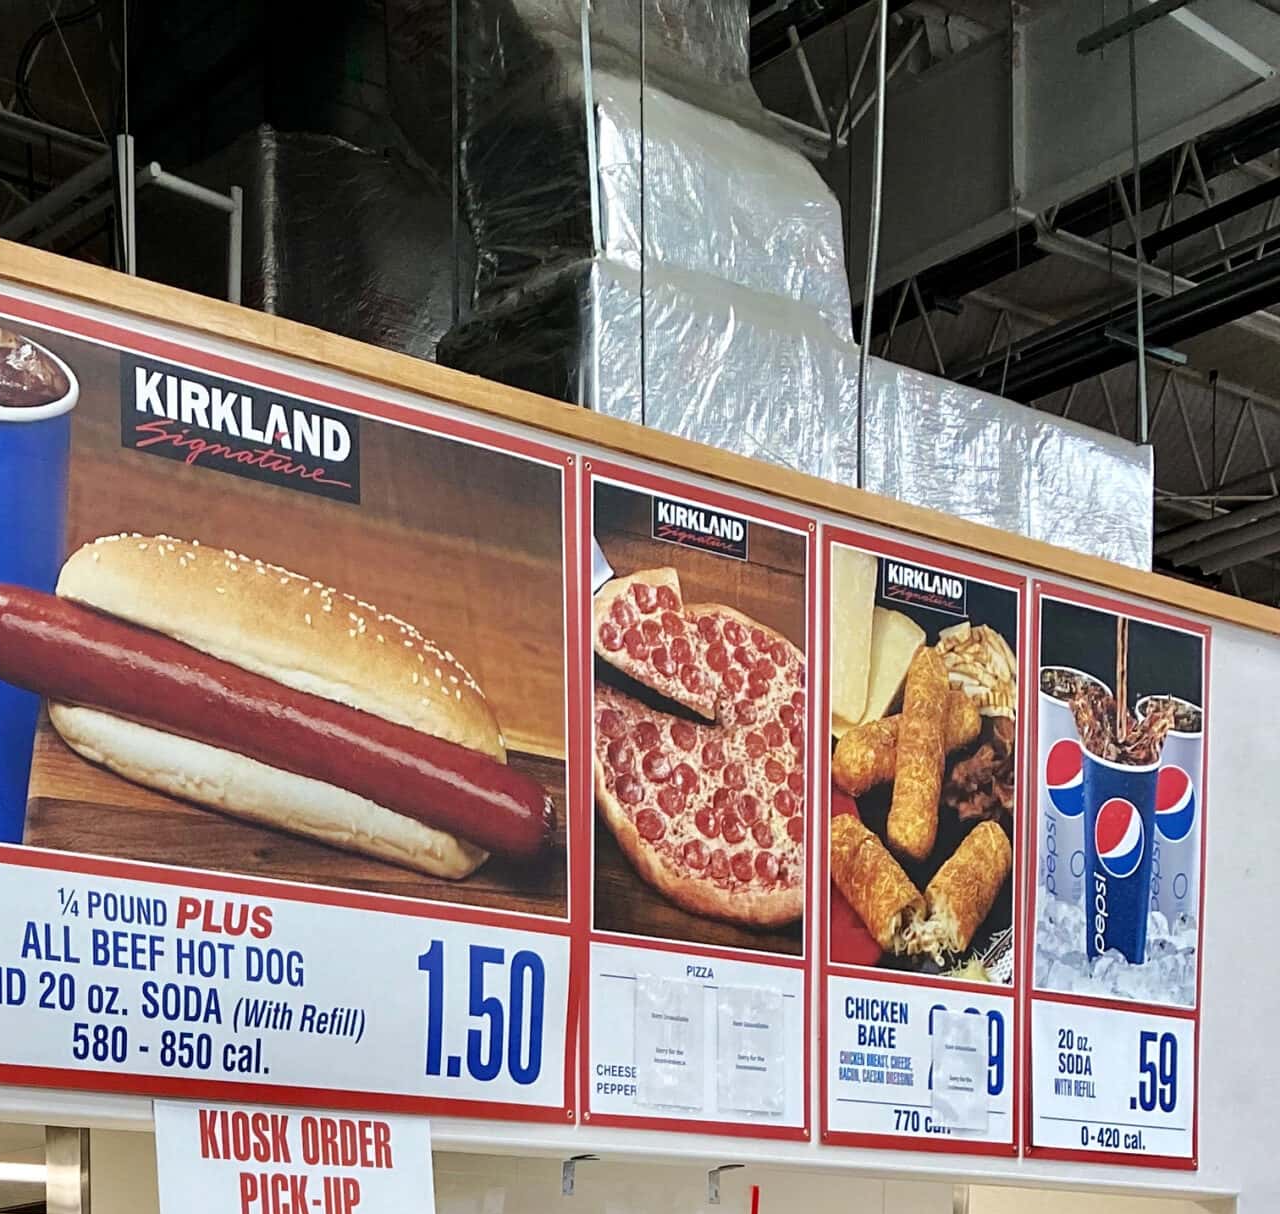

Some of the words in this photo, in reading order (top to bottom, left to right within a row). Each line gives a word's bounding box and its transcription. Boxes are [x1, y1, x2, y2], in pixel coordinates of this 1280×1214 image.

[135, 366, 351, 462] KIRKLAND
[135, 419, 352, 488] Signature
[658, 501, 744, 542] KIRKLAND
[888, 563, 963, 599] KIRKLAND
[86, 892, 167, 927] POUND
[175, 896, 273, 939] PLUS
[20, 921, 80, 964] ALL
[92, 928, 165, 971] BEEF
[175, 938, 235, 980] HOT
[245, 946, 305, 988] DOG
[686, 965, 714, 980] PIZZA
[38, 971, 75, 1012] 20
[87, 986, 128, 1016] oz.
[141, 983, 222, 1025] SODA
[232, 995, 294, 1035] (With
[298, 1004, 367, 1045] Refill)
[417, 938, 546, 1086] 1.50
[845, 996, 909, 1024] CHICKEN
[72, 1022, 128, 1062] 580
[159, 1032, 212, 1071] 850
[222, 1038, 271, 1076] cal.
[858, 1024, 896, 1049] BAKE
[1058, 1029, 1074, 1049] 20
[1077, 1036, 1092, 1051] oz.
[596, 1064, 637, 1079] CHEESE
[1058, 1053, 1092, 1075] SODA
[1130, 1030, 1178, 1113] .59
[1054, 1078, 1072, 1096] WITH
[1074, 1080, 1096, 1098] REFILL
[198, 1108, 290, 1164] KIOSK
[300, 1115, 394, 1170] ORDER
[894, 1109, 920, 1132] 770
[1124, 1131, 1145, 1150] cal.
